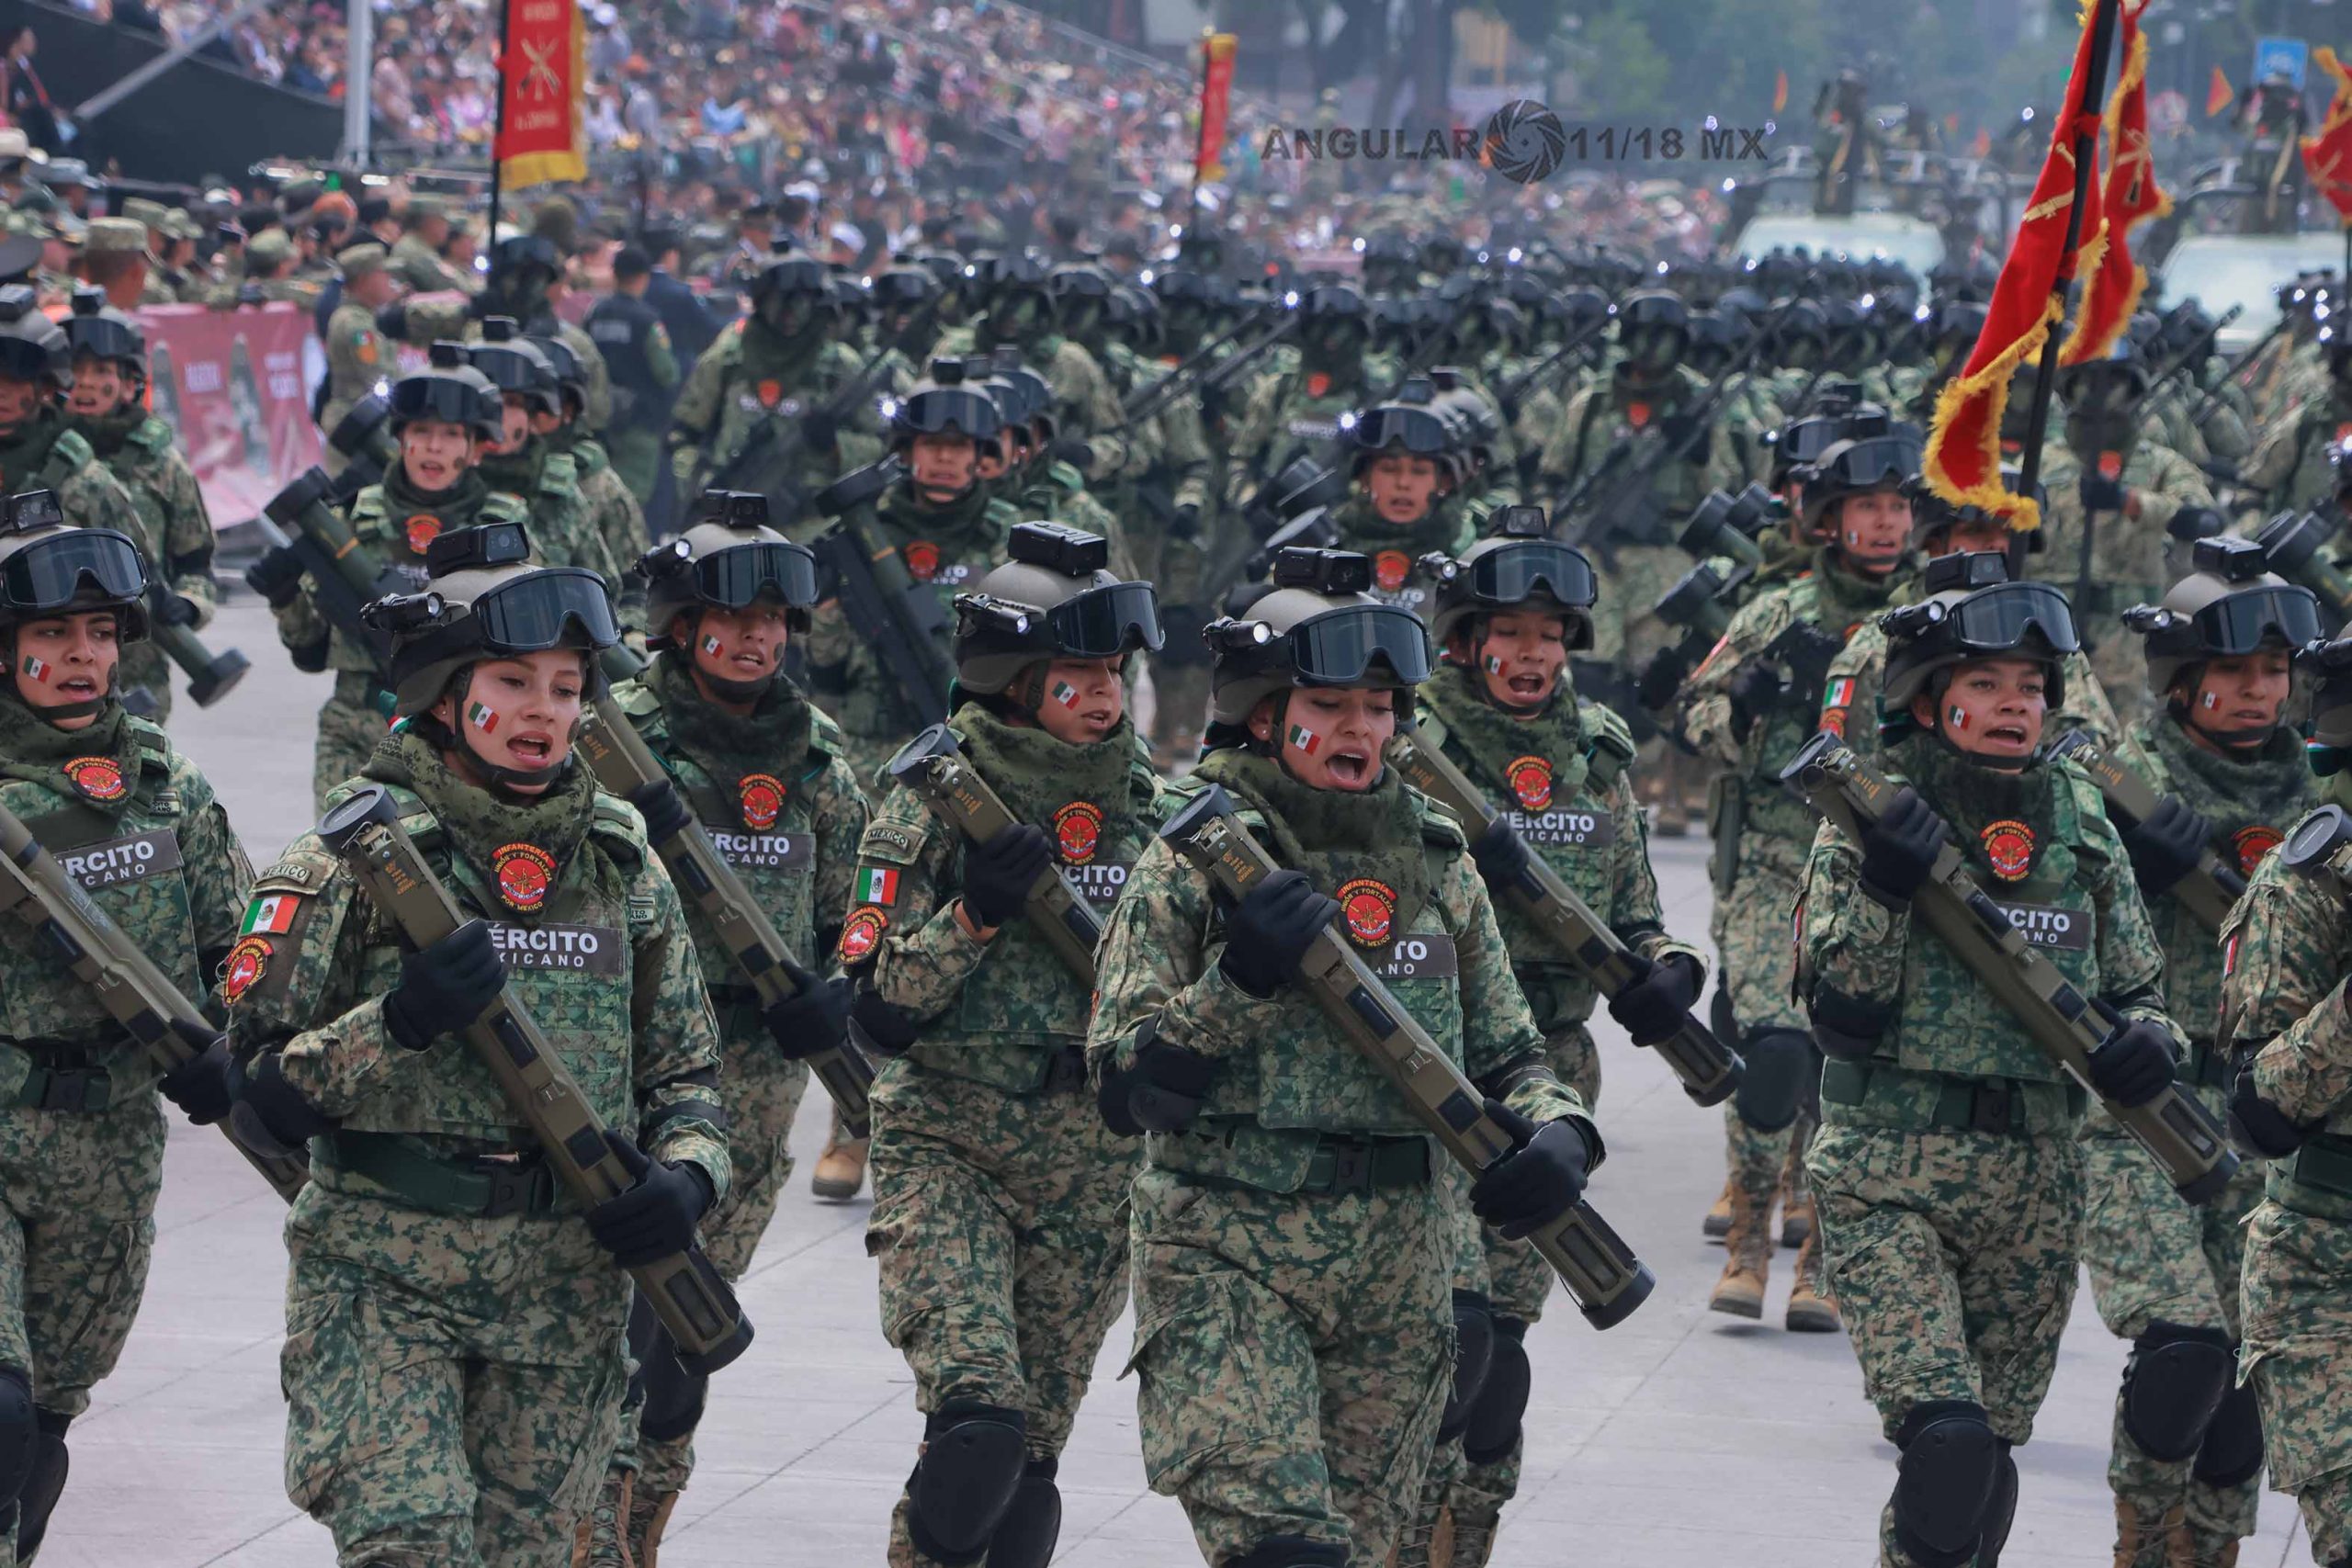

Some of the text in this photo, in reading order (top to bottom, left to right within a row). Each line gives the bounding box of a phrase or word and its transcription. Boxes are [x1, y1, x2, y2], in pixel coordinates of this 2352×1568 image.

[708, 832, 790, 854] RCITO
[58, 840, 154, 876] RCITO
[727, 853, 779, 865] CANO
[85, 863, 145, 886] CANO
[1063, 865, 1126, 885] CITO
[488, 924, 598, 954] ÉRCITO
[500, 952, 584, 967] ICANO
